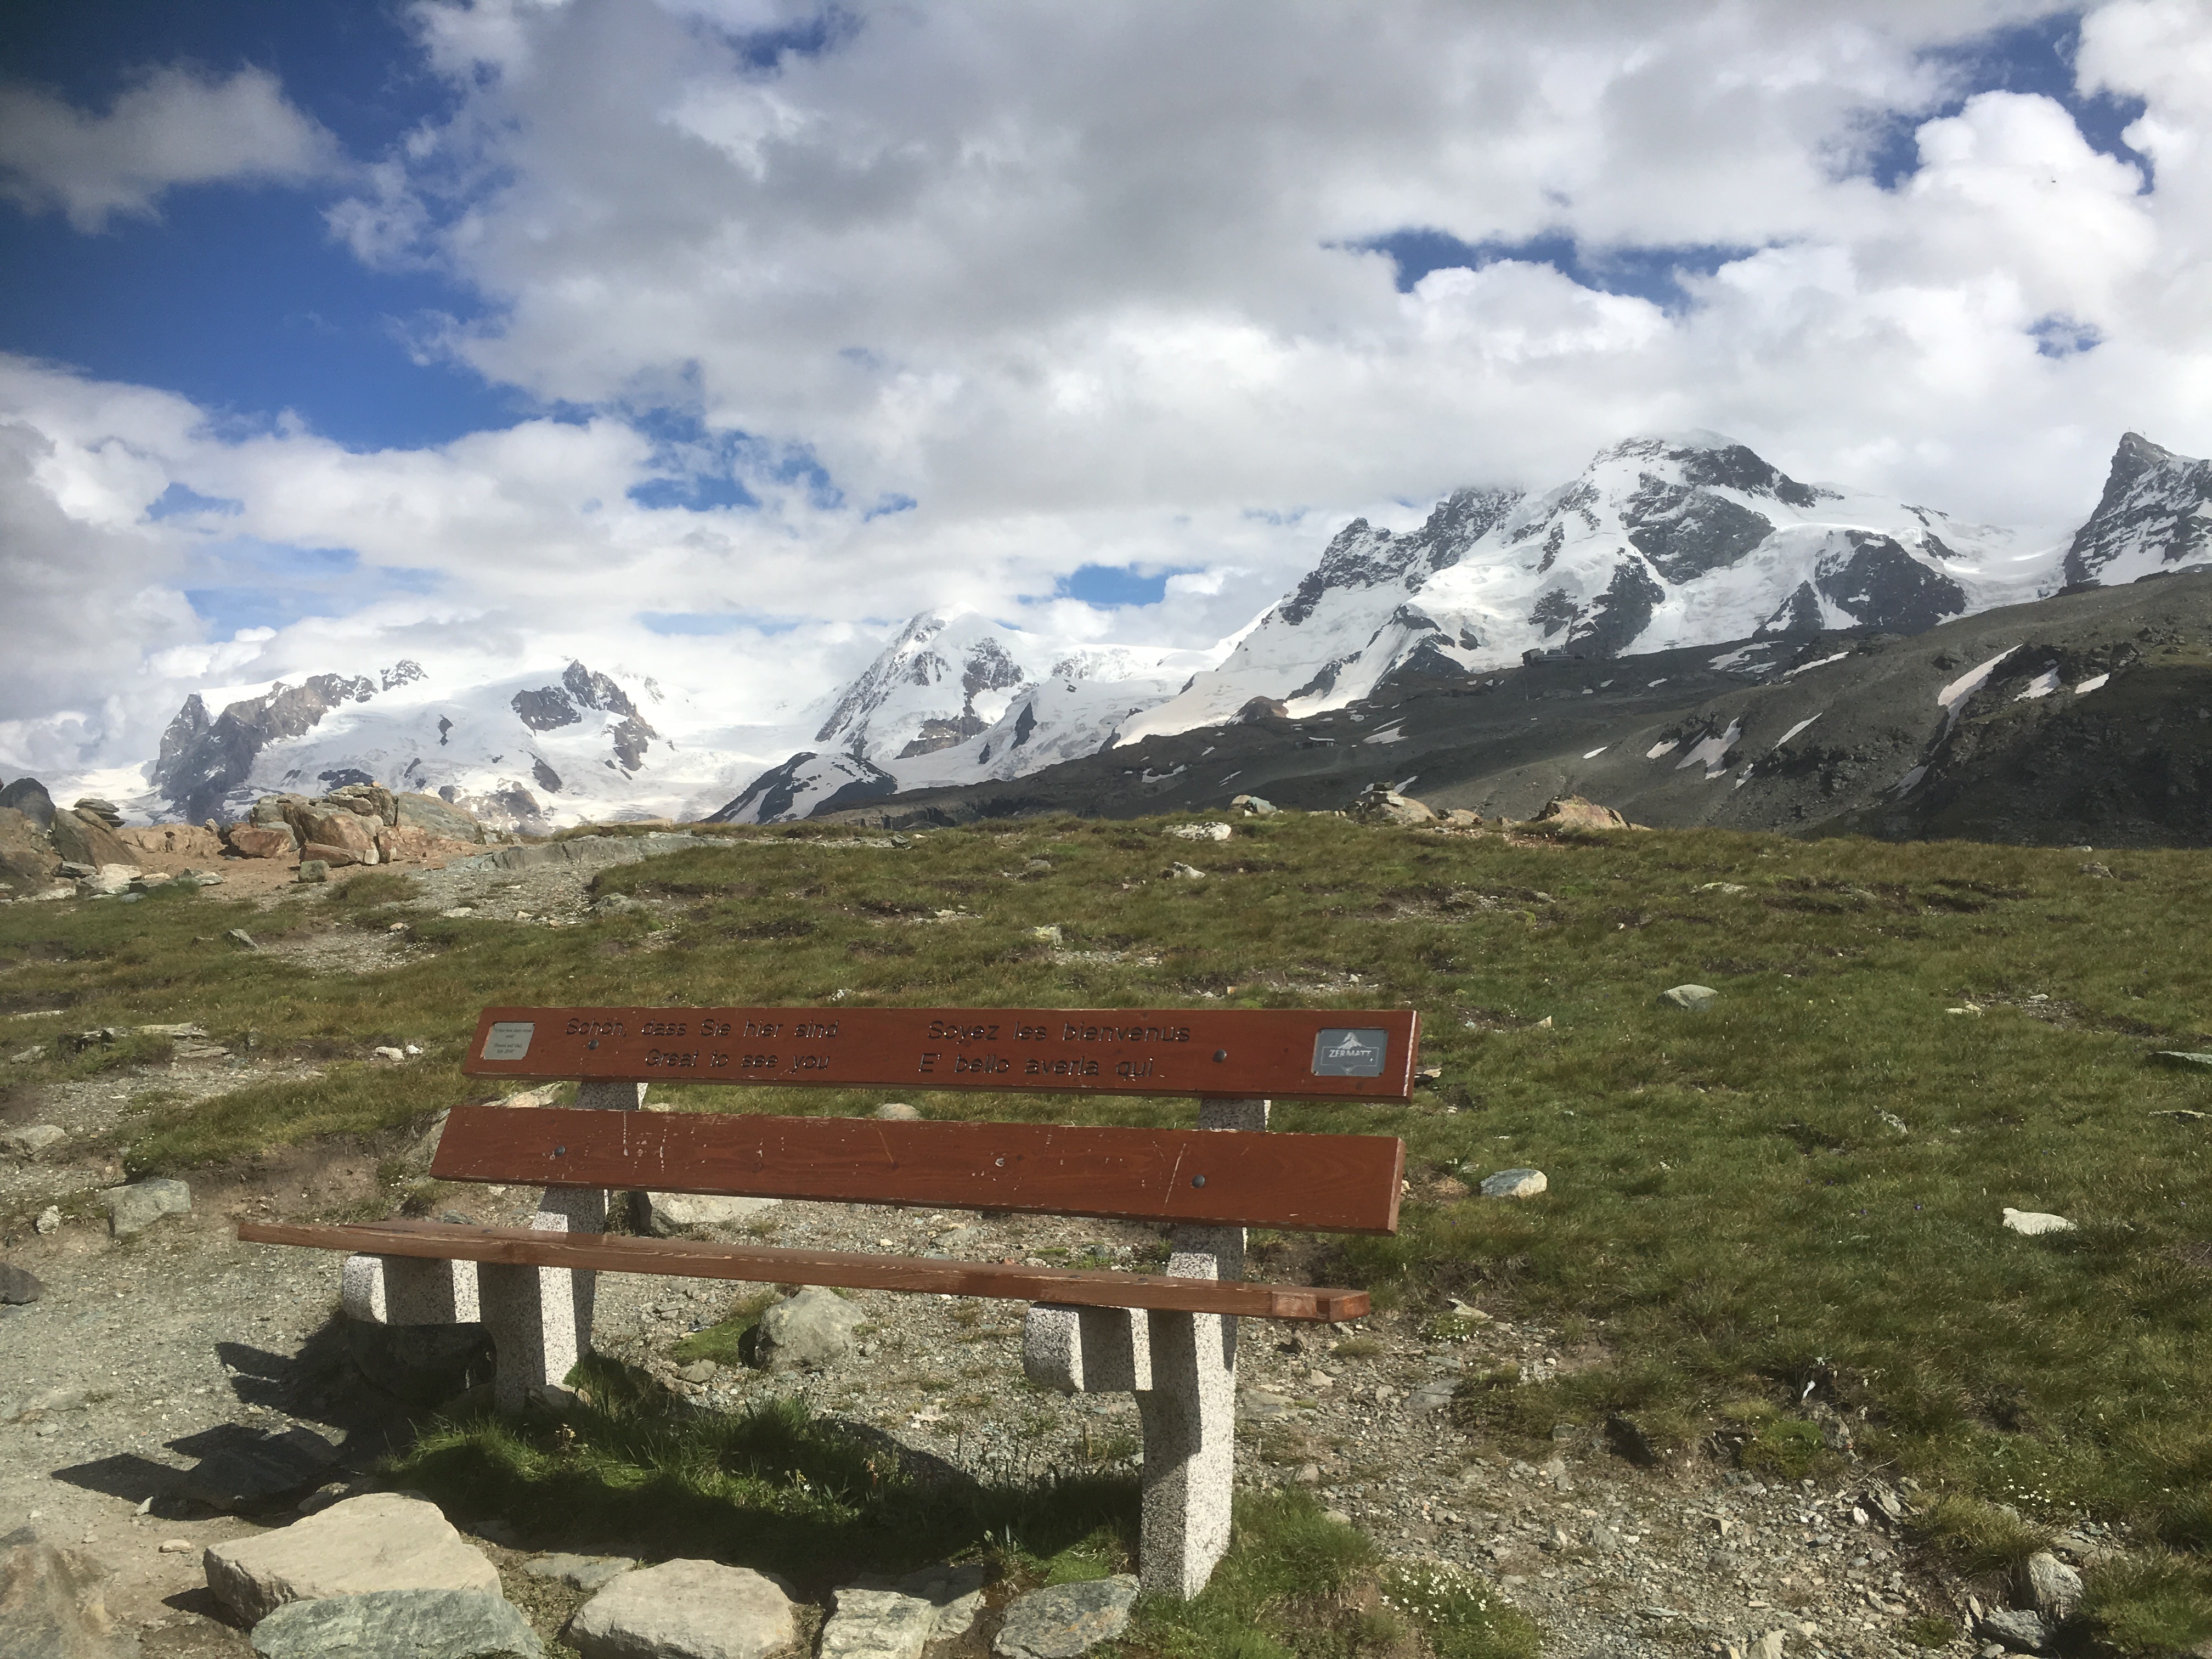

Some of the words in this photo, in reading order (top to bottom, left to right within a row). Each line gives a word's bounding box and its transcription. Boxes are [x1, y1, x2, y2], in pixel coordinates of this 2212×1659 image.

[641, 1018, 687, 1037] dass
[699, 1018, 731, 1037] Sie
[743, 1019, 784, 1038] hier
[794, 1020, 839, 1038] sind
[927, 1020, 1000, 1045] Soyez
[1013, 1021, 1047, 1041] les
[1062, 1022, 1191, 1042] bienvenus
[645, 1048, 699, 1066] Great
[709, 1049, 729, 1068] to
[741, 1053, 778, 1069] see
[789, 1055, 830, 1074] you
[954, 1053, 1009, 1074] bello
[1024, 1056, 1099, 1076] averla
[1115, 1057, 1154, 1080] qui
